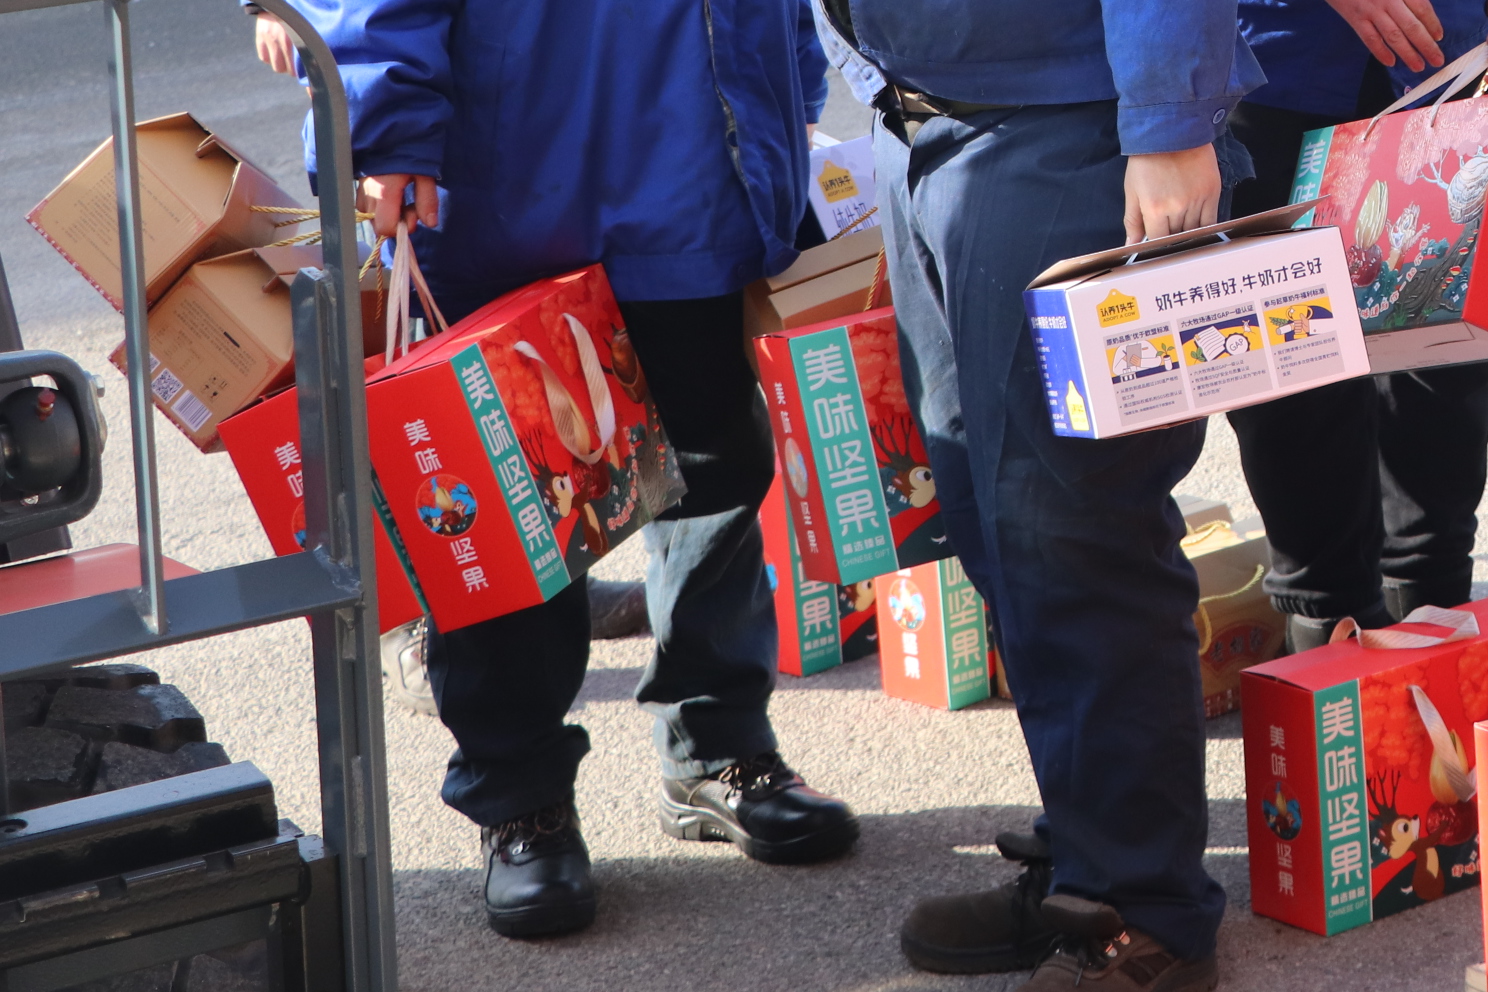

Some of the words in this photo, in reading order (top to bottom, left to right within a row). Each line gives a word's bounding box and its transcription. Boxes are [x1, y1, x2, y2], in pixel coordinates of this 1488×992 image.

[1100, 301, 1135, 317] 认养1头牛
[1155, 257, 1323, 312] 奶牛养得好,牛奶才会好
[1103, 315, 1119, 323] ADOPT
[1180, 305, 1253, 328] 六大牧场通过GAP一级认证
[1229, 338, 1244, 352] GAP
[461, 361, 550, 554] 美味坚果
[803, 344, 879, 537] 美味坚果
[404, 419, 442, 474] 美味
[451, 537, 489, 593] 坚果
[842, 552, 873, 568] CHINESE
[874, 547, 891, 560] GIFT
[1270, 725, 1287, 778] 美味
[1322, 697, 1363, 888] 美味坚果
[1277, 842, 1294, 897] 坚果
[1328, 902, 1354, 919] CHINESE
[1354, 898, 1369, 911] GIFT
